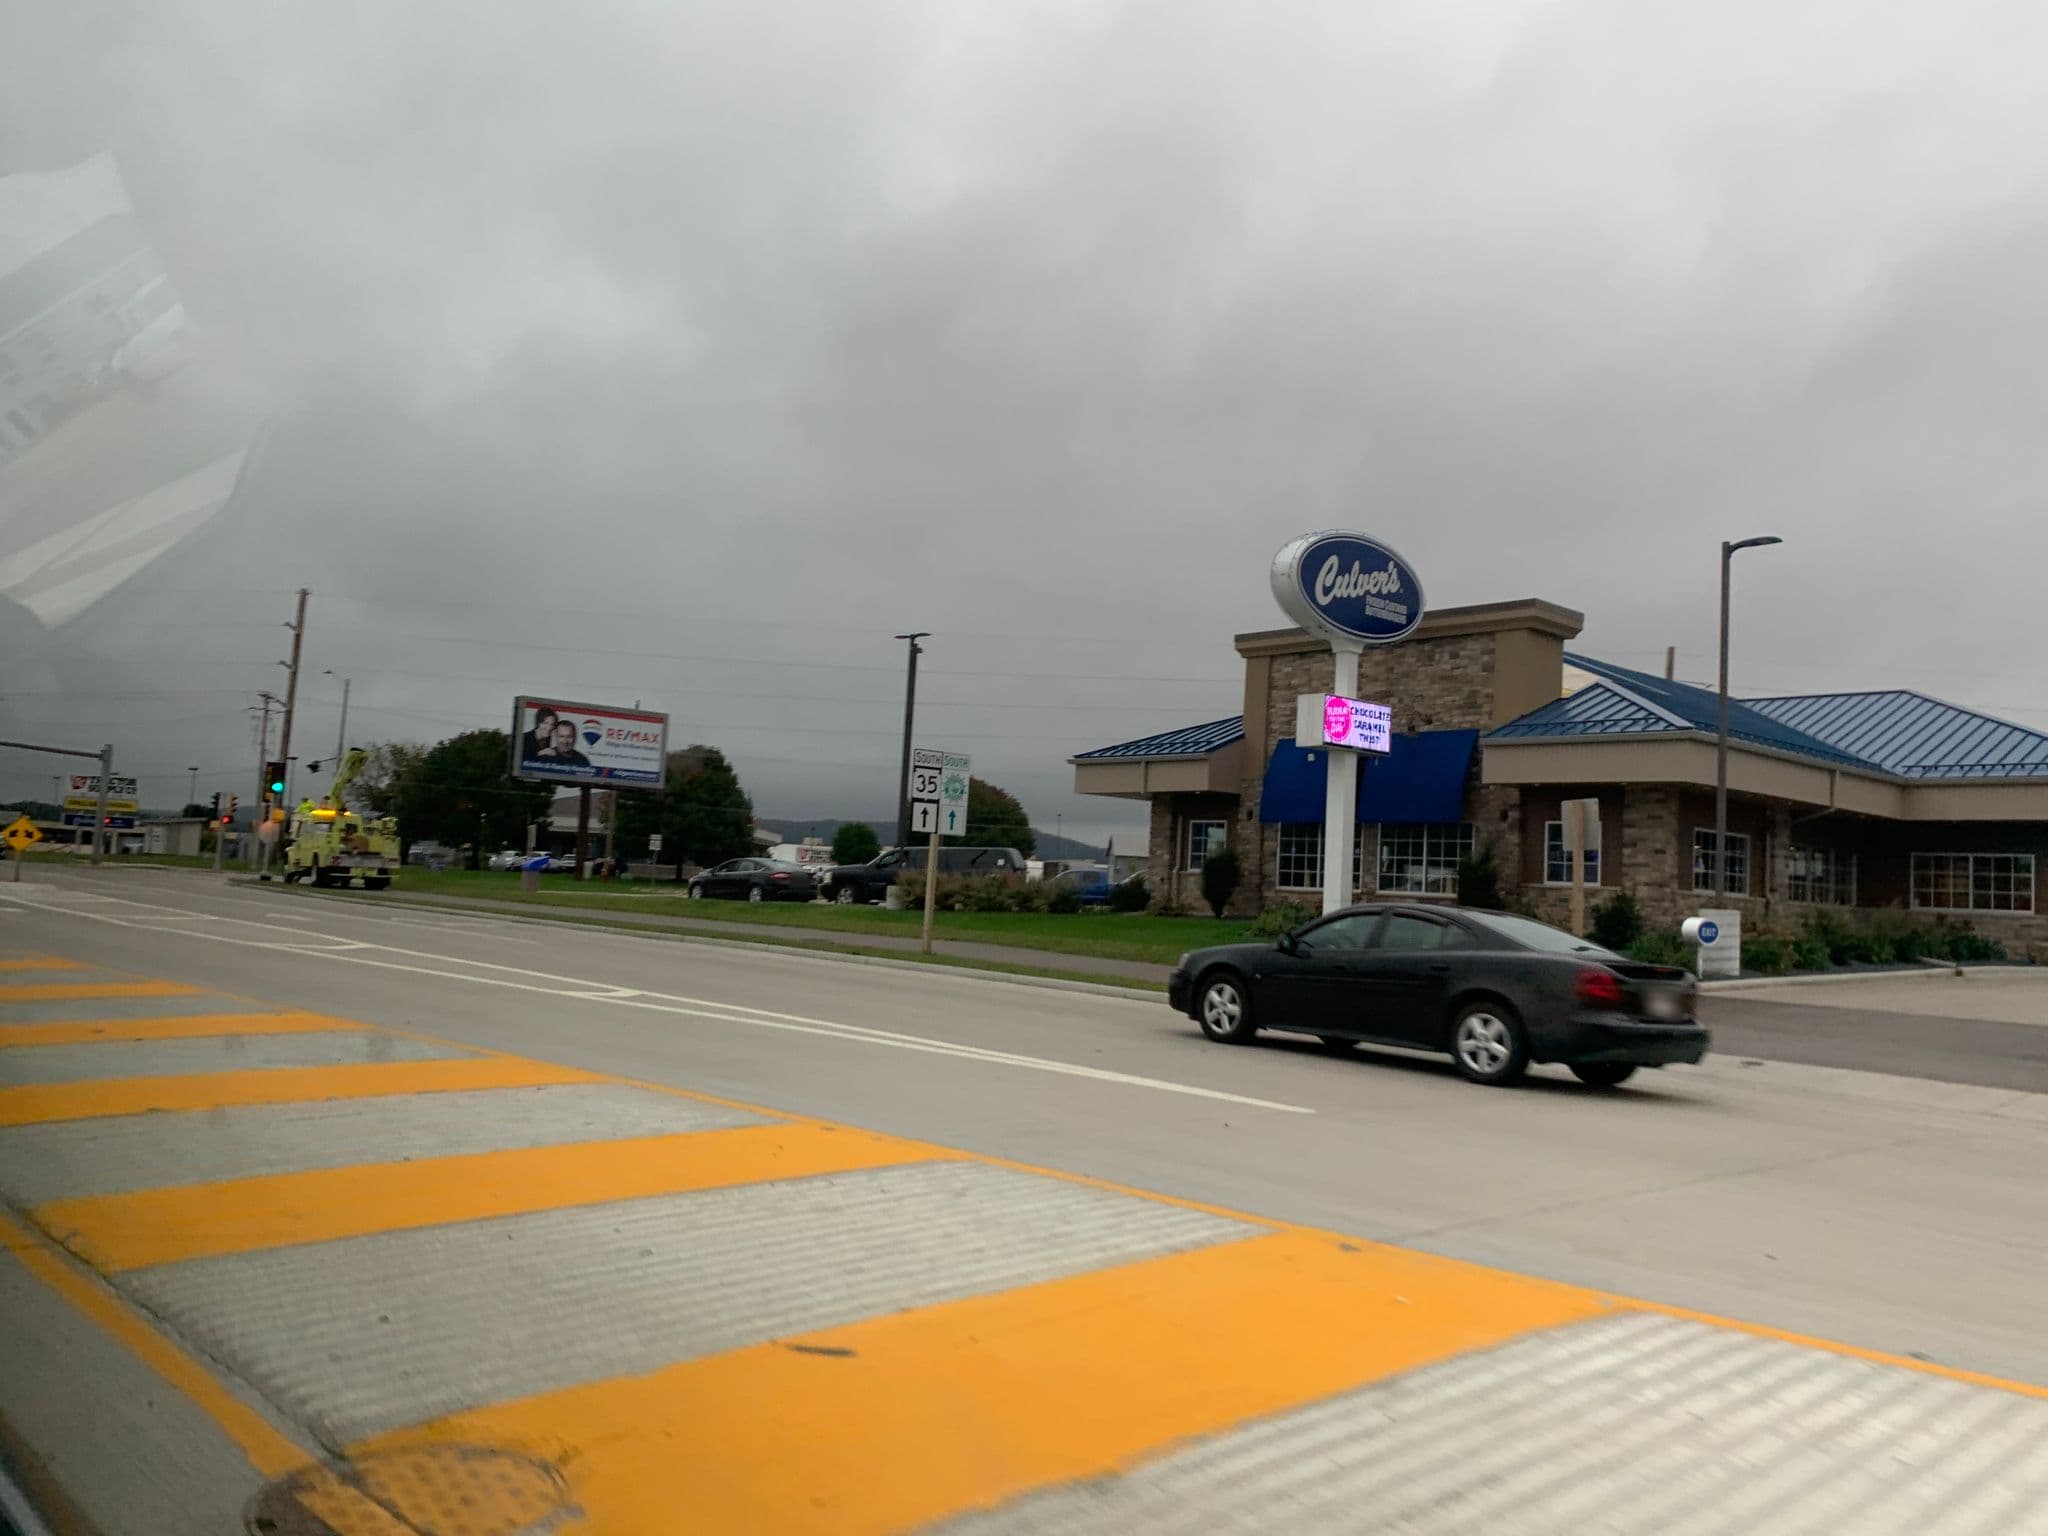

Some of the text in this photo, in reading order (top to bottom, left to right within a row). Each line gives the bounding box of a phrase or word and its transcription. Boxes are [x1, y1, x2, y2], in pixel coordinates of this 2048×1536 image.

[1315, 554, 1401, 606] Culver's
[1350, 706, 1392, 722] CHOCOLATE
[606, 728, 660, 743] RE/MAX
[916, 751, 941, 767] SOUTH
[944, 754, 969, 769] SOUTH
[915, 774, 938, 794] 35
